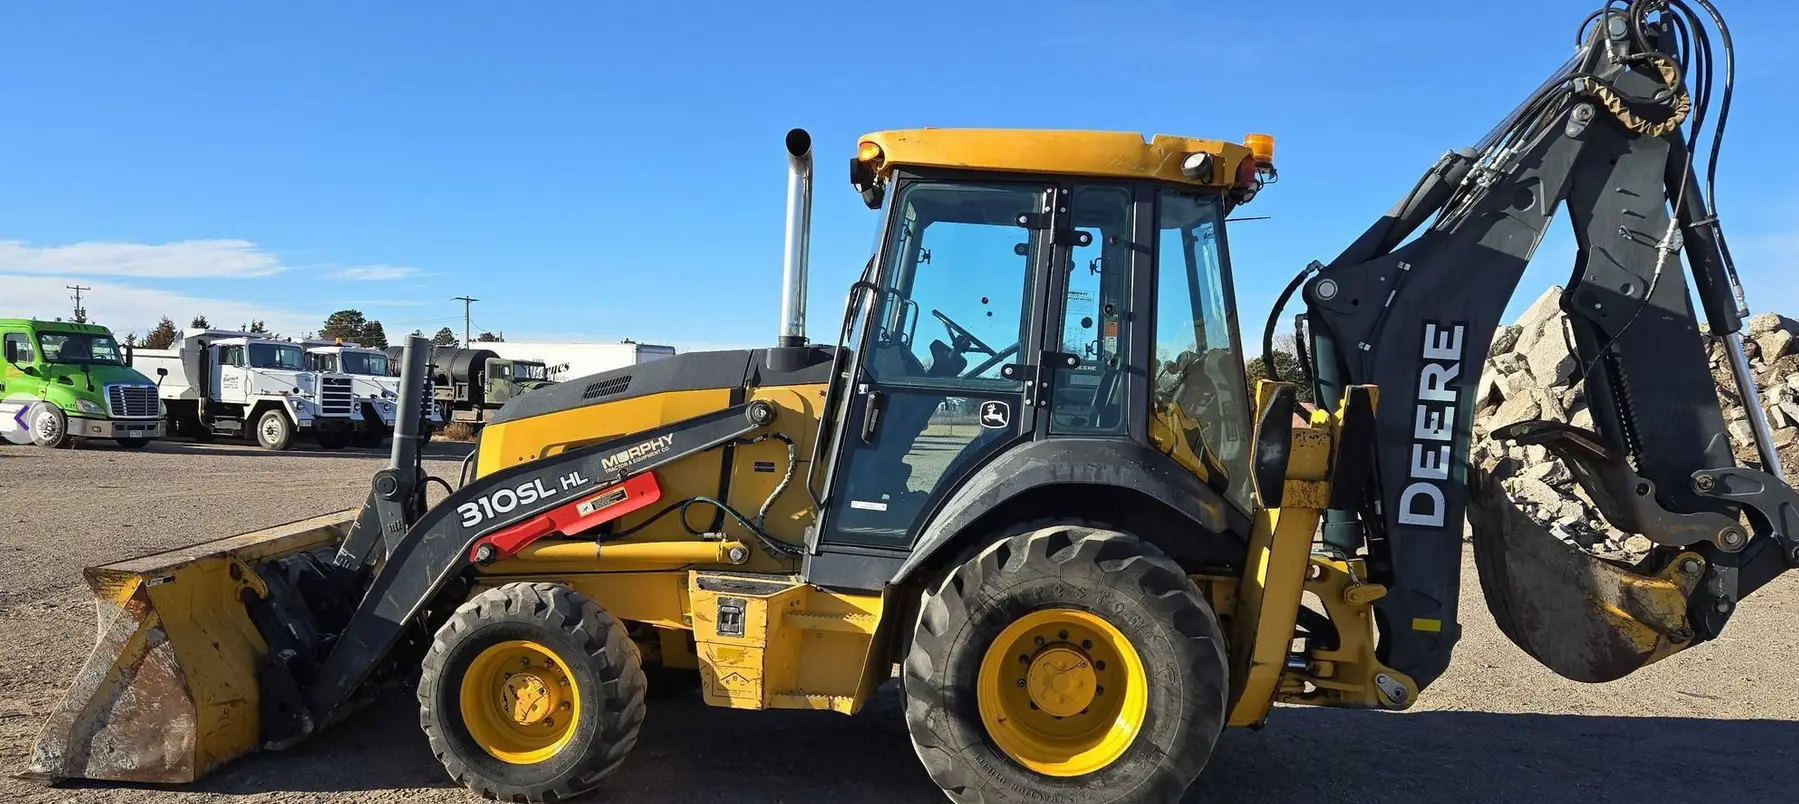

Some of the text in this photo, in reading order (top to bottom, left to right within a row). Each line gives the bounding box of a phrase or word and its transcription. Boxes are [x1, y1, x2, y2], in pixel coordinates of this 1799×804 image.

[600, 432, 674, 470] MURPHY
[1399, 323, 1464, 527] DEERE
[457, 478, 556, 528] 310SL
[560, 471, 588, 491] HL
